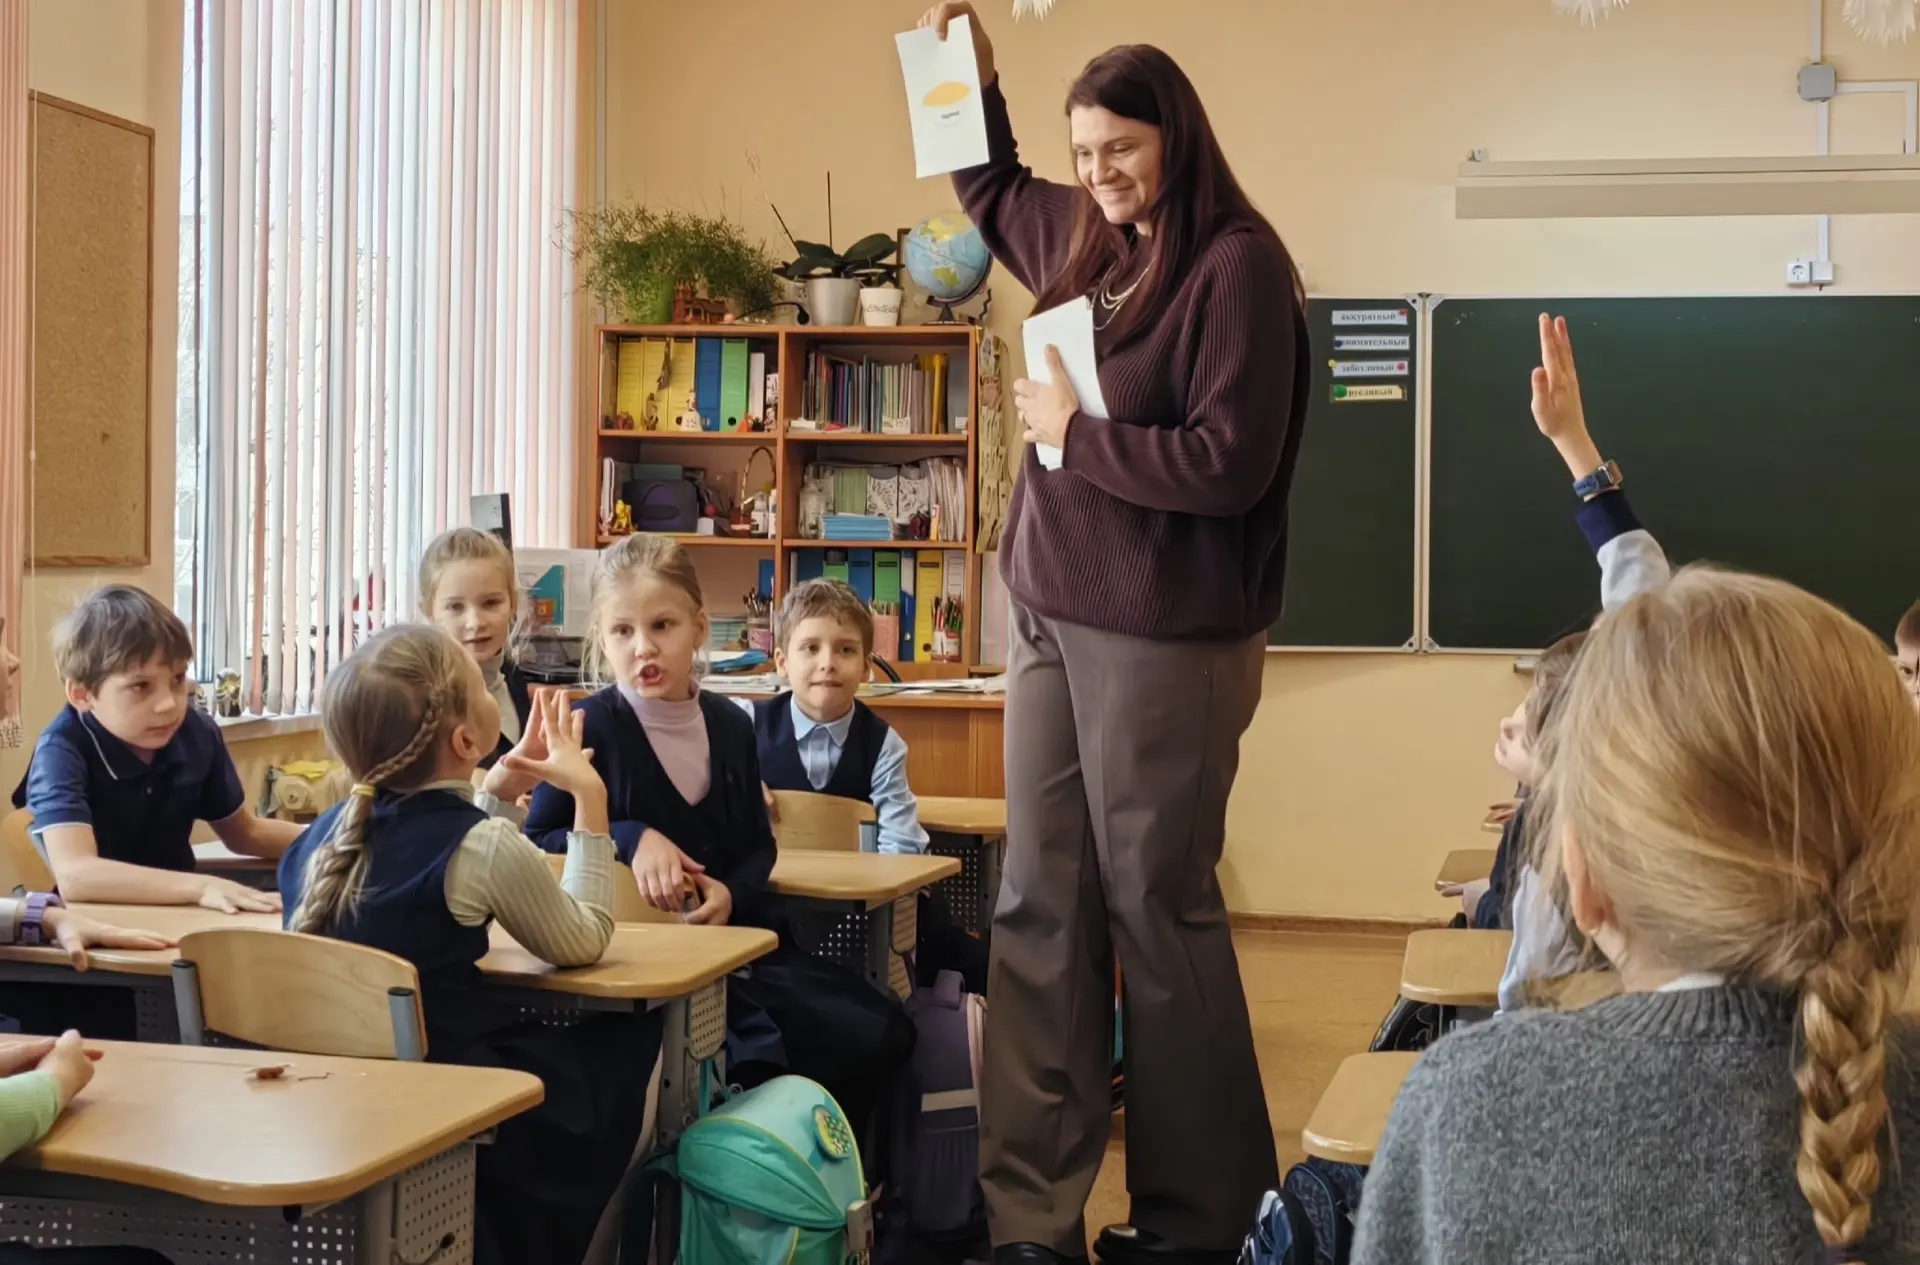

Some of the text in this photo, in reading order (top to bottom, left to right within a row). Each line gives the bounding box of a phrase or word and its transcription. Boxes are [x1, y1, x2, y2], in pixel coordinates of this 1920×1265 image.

[1341, 313, 1396, 323] аккуратный
[1342, 363, 1394, 373] заботливый
[1348, 388, 1393, 397] русливый
